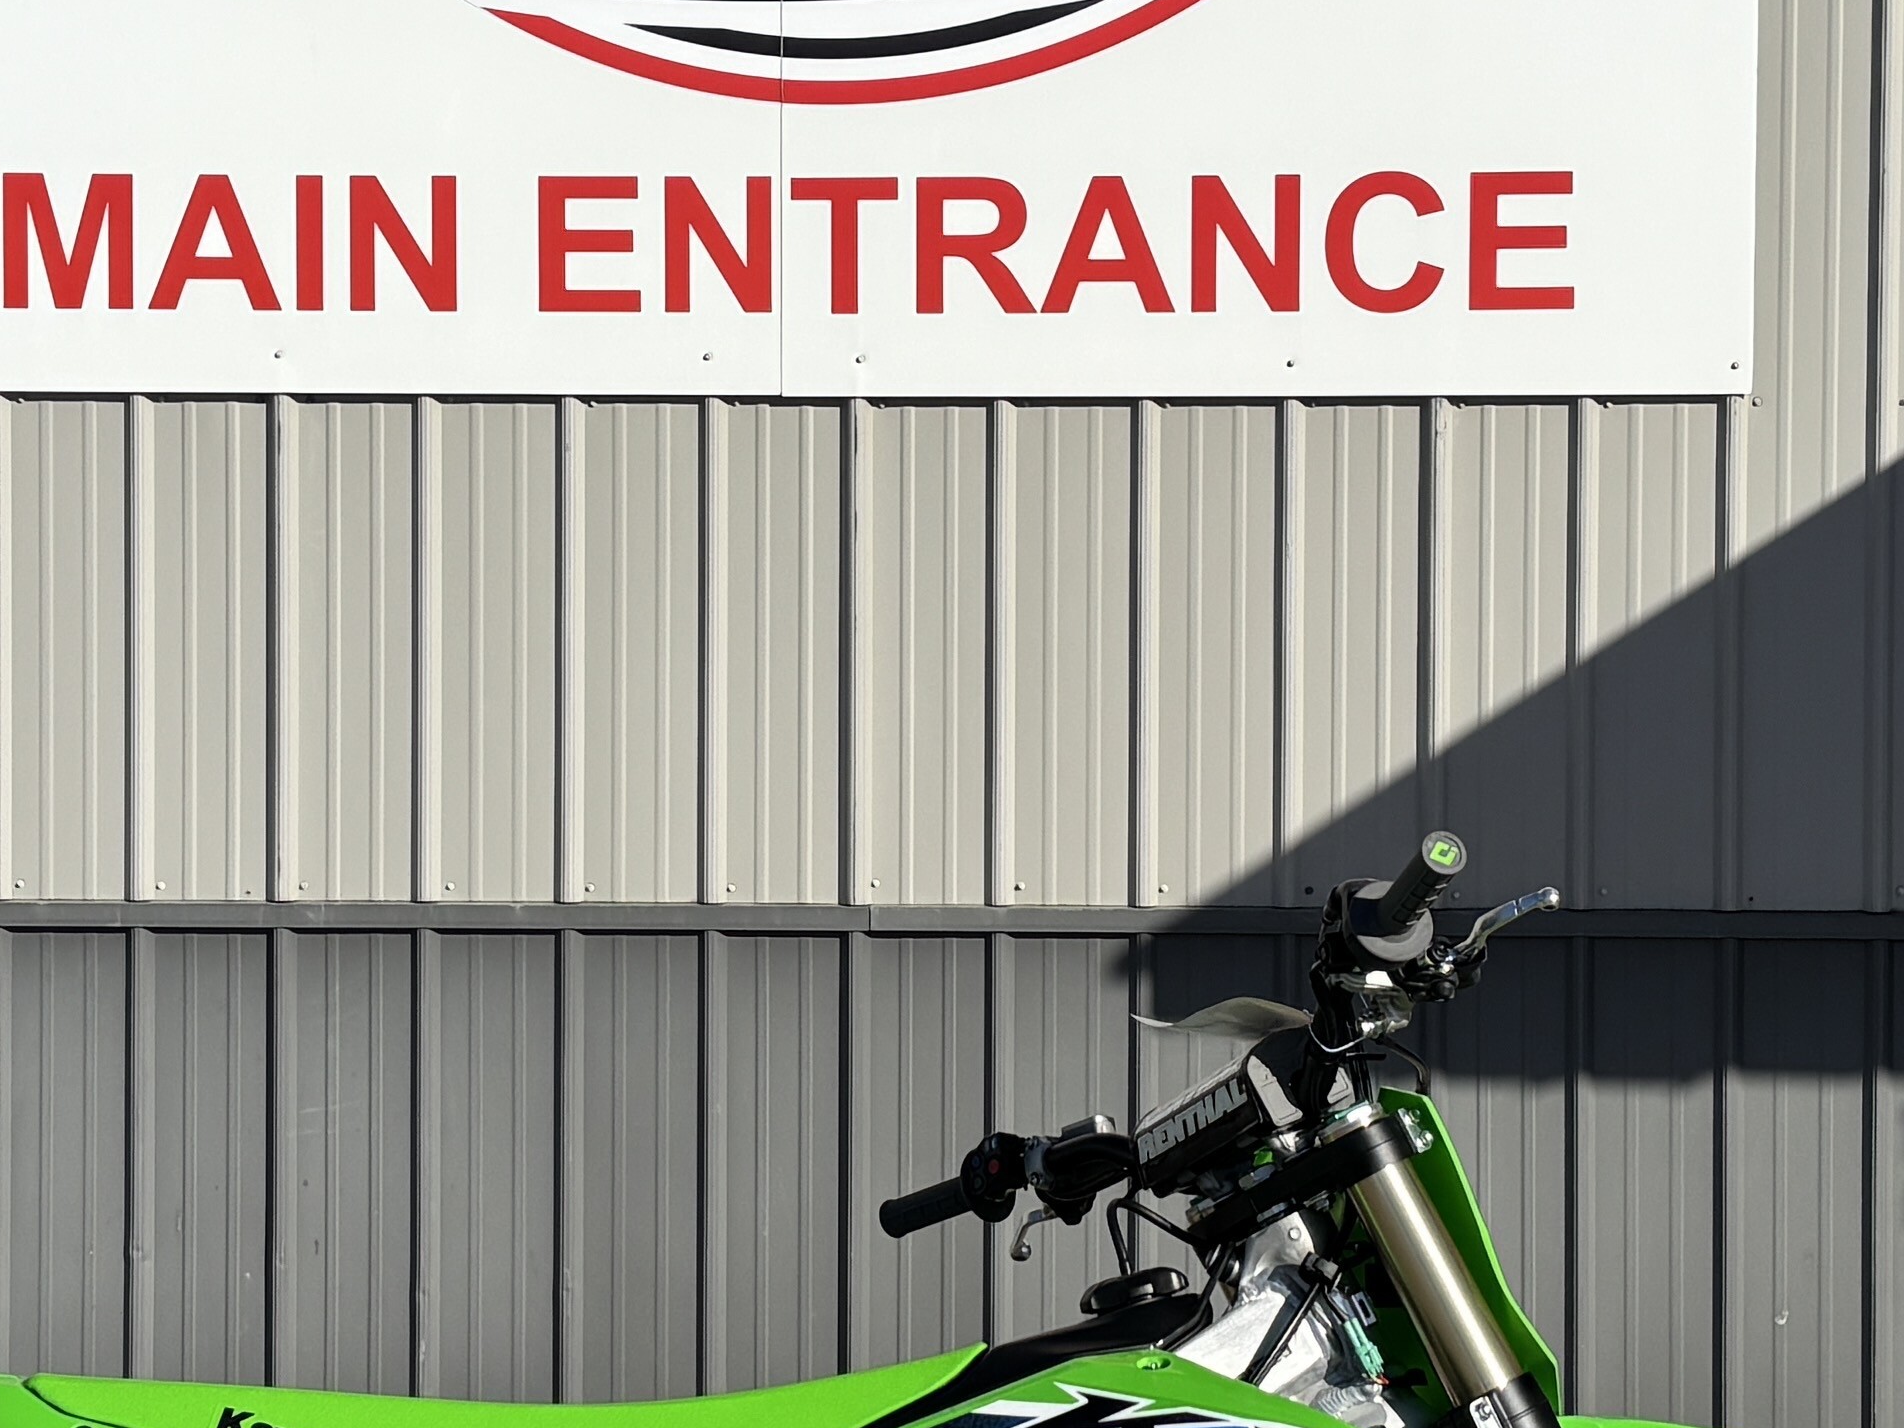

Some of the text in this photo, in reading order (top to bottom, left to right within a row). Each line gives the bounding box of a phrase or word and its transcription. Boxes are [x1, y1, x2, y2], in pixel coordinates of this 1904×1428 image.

[1, 170, 1575, 314] MAIN ENTRANCE
[1137, 1076, 1247, 1165] RENTHAL
